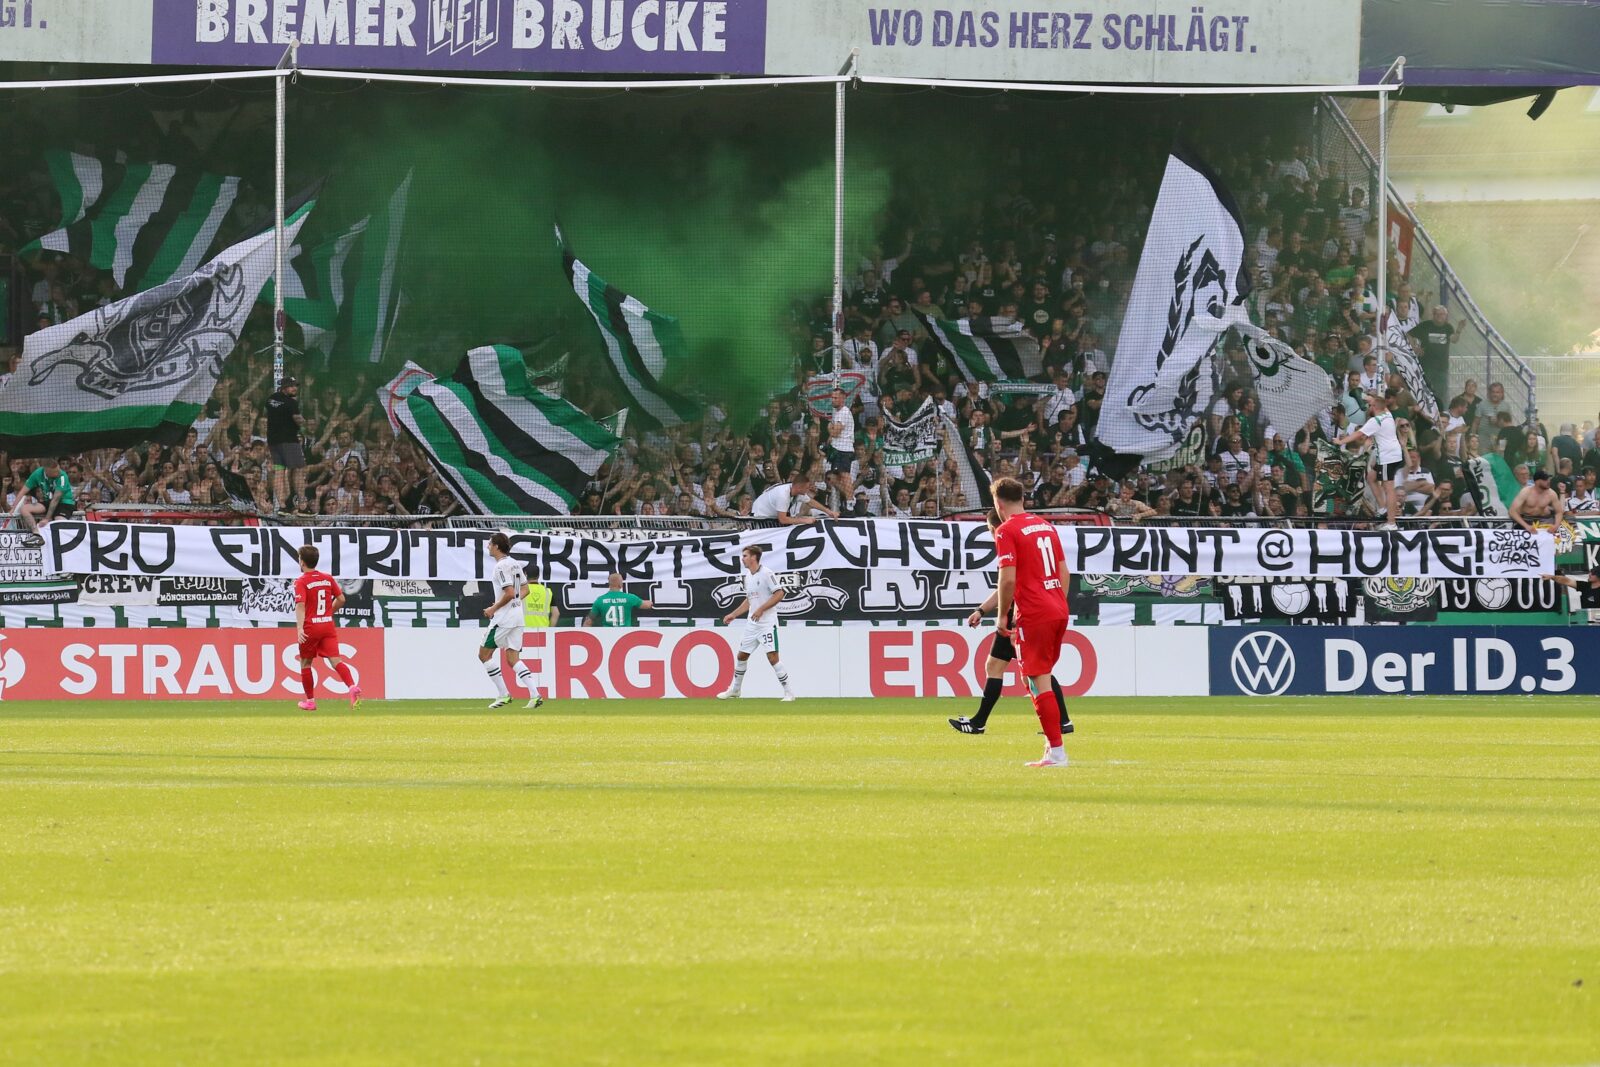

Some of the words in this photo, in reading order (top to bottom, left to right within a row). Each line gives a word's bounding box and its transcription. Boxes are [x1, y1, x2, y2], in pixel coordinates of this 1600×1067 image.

[195, 0, 417, 46] BREMER
[868, 8, 922, 48] WO
[931, 9, 1000, 48] DAS
[1008, 11, 1093, 51] HERZ
[1102, 7, 1257, 54] SCHLÄGT.
[50, 521, 176, 574] PRO
[1075, 527, 1240, 573] PRINT
[1257, 529, 1294, 571] @
[1309, 529, 1484, 576] HOME!
[1037, 536, 1056, 577] 11
[84, 574, 154, 594] CREW
[160, 592, 238, 602] MÖNCHENGLADBACH
[317, 589, 326, 616] 6
[605, 606, 625, 626] 41
[762, 632, 774, 645] 39
[59, 643, 361, 695] STRAUSS
[500, 630, 736, 698] ERGO
[1324, 638, 1436, 693] Der
[1453, 636, 1577, 693] ID.3
